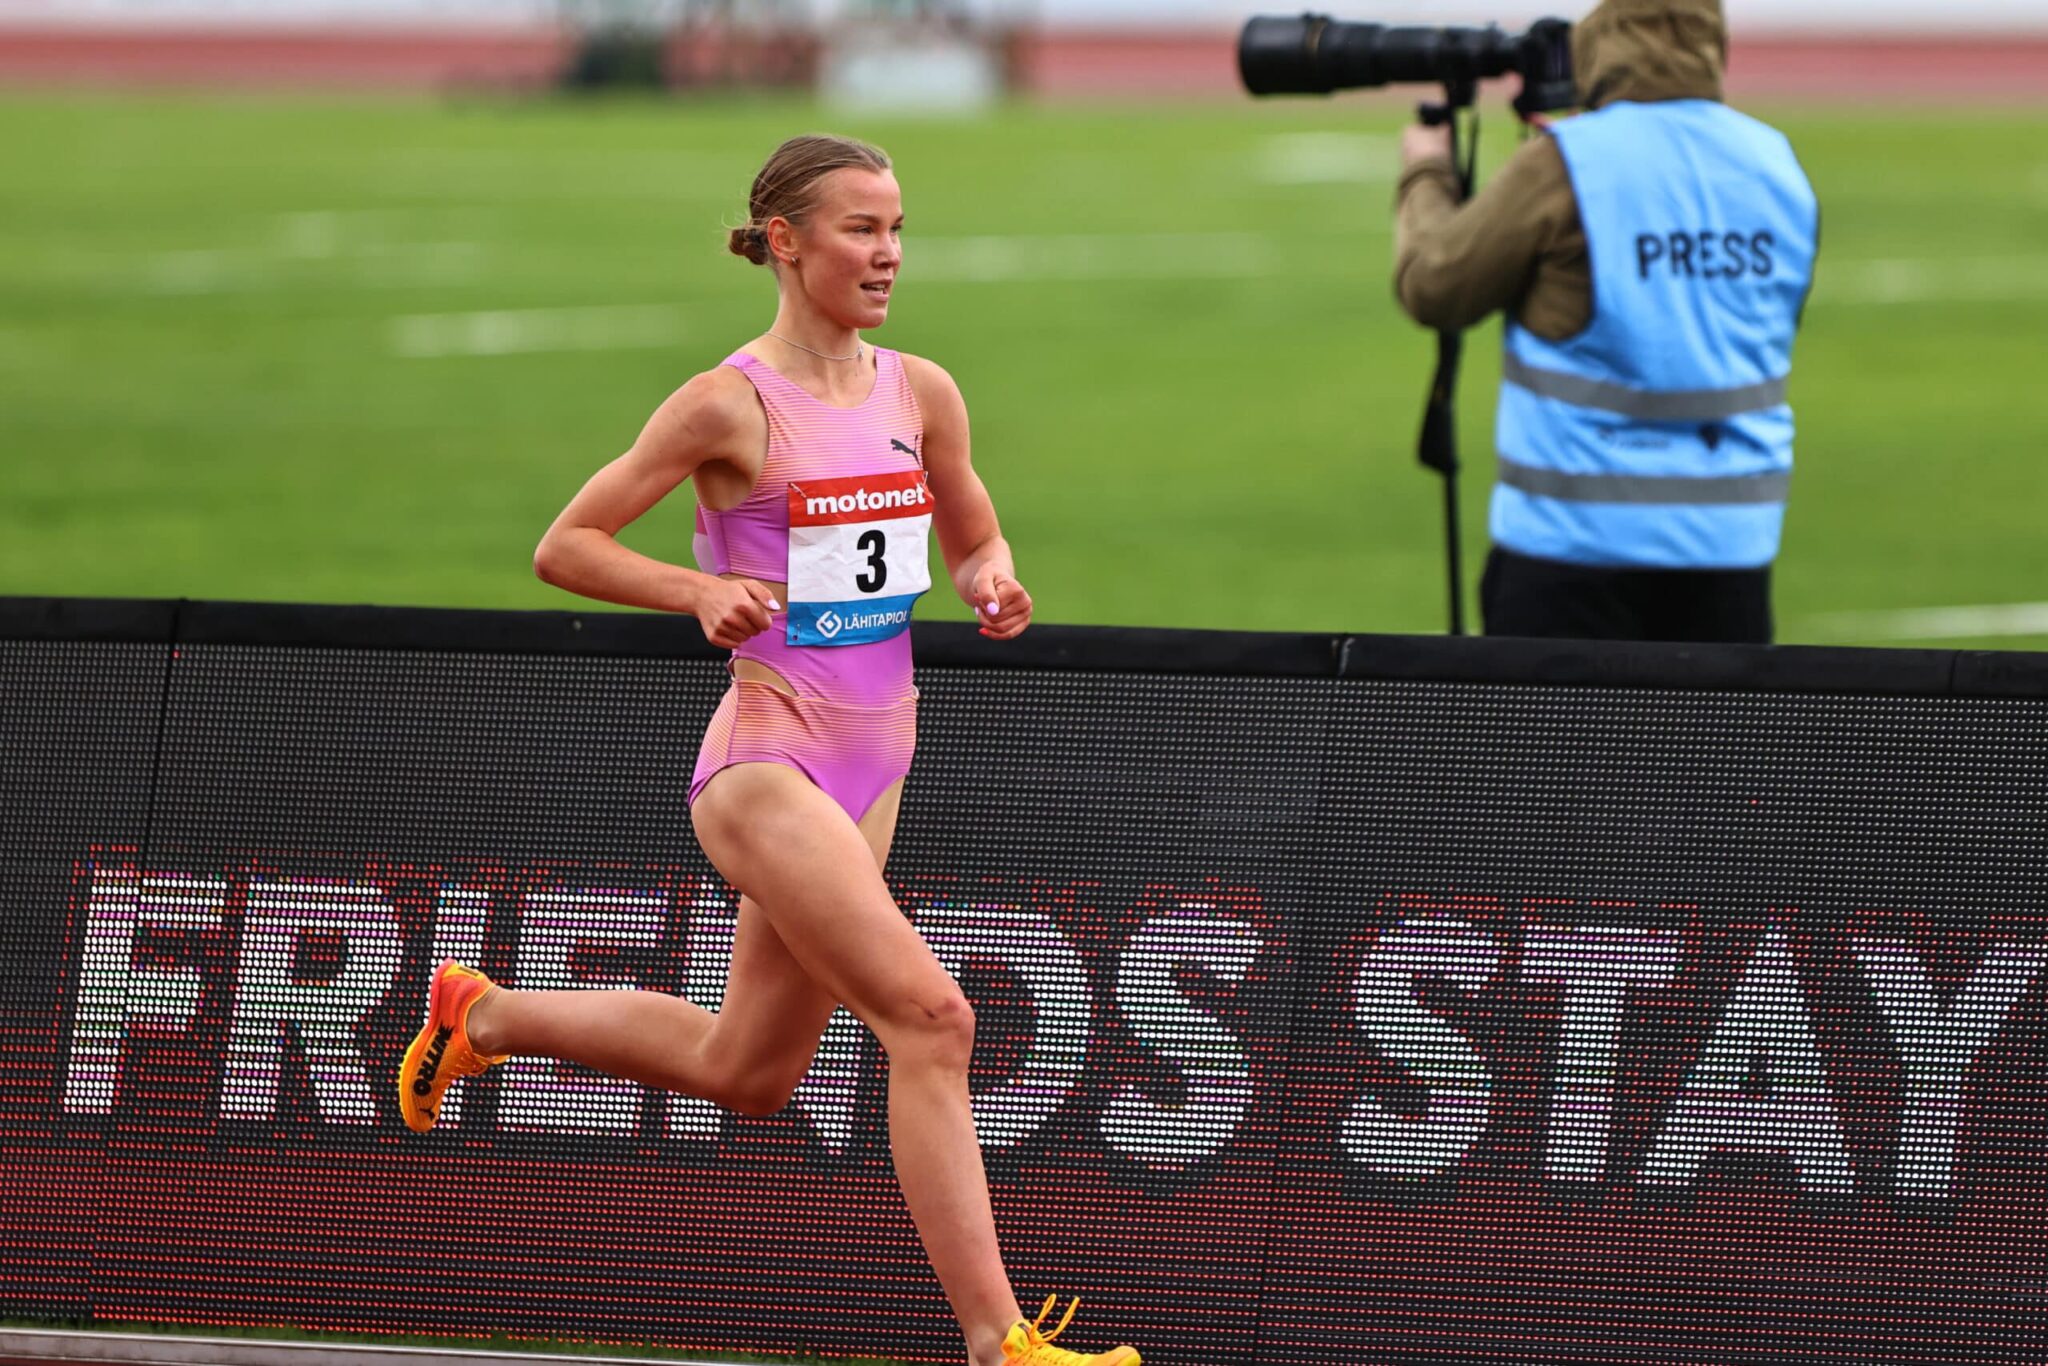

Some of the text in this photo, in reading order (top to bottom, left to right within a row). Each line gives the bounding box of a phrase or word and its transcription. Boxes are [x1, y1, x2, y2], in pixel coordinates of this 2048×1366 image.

[1635, 228, 1776, 281] PRESS
[806, 483, 926, 516] motonet
[855, 529, 887, 593] 3
[844, 610, 908, 631] LÄHITAPIOL
[413, 1021, 455, 1097] NITRO
[1339, 912, 2048, 1198] STAY
